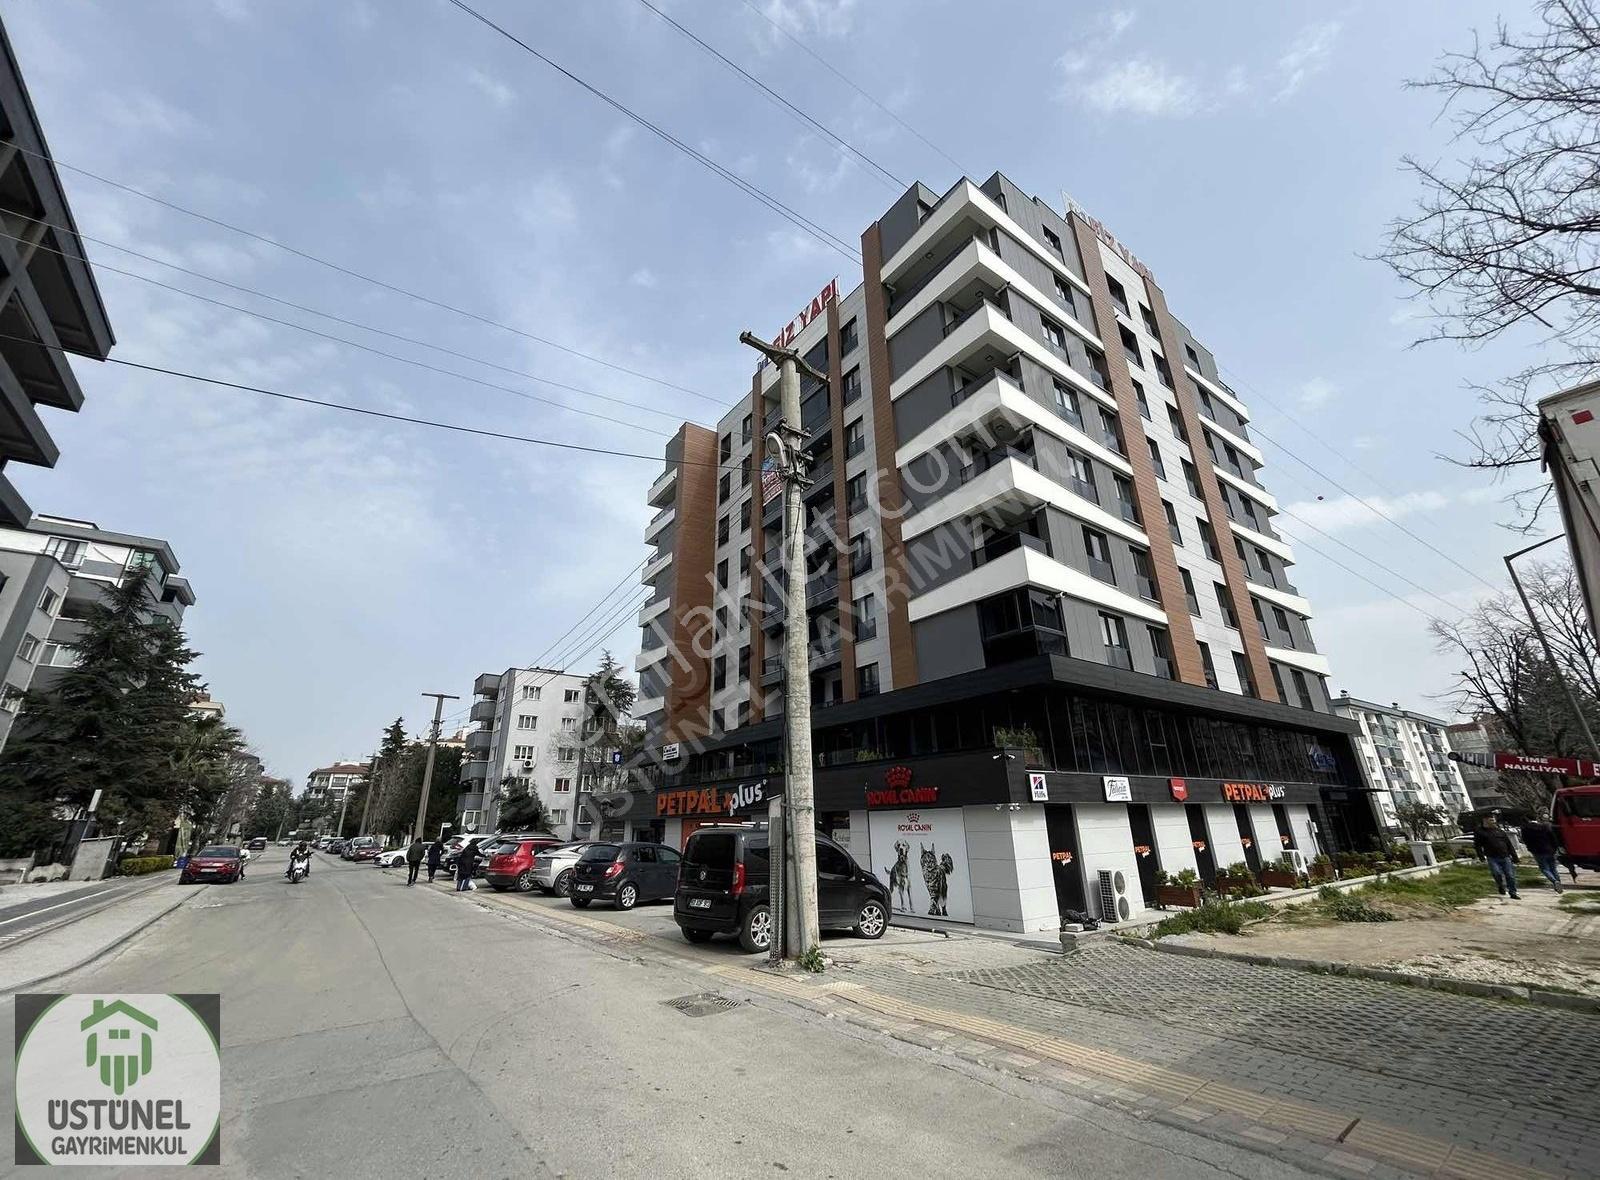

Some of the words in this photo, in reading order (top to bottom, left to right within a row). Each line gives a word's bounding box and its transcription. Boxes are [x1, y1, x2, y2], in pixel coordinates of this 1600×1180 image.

[799, 278, 837, 328] YAPI
[1504, 763, 1568, 774] NAKLİYAT
[656, 785, 721, 816] PETPAL
[729, 783, 763, 817] plus
[1223, 783, 1267, 801] PETPAL
[1268, 784, 1286, 800] plus
